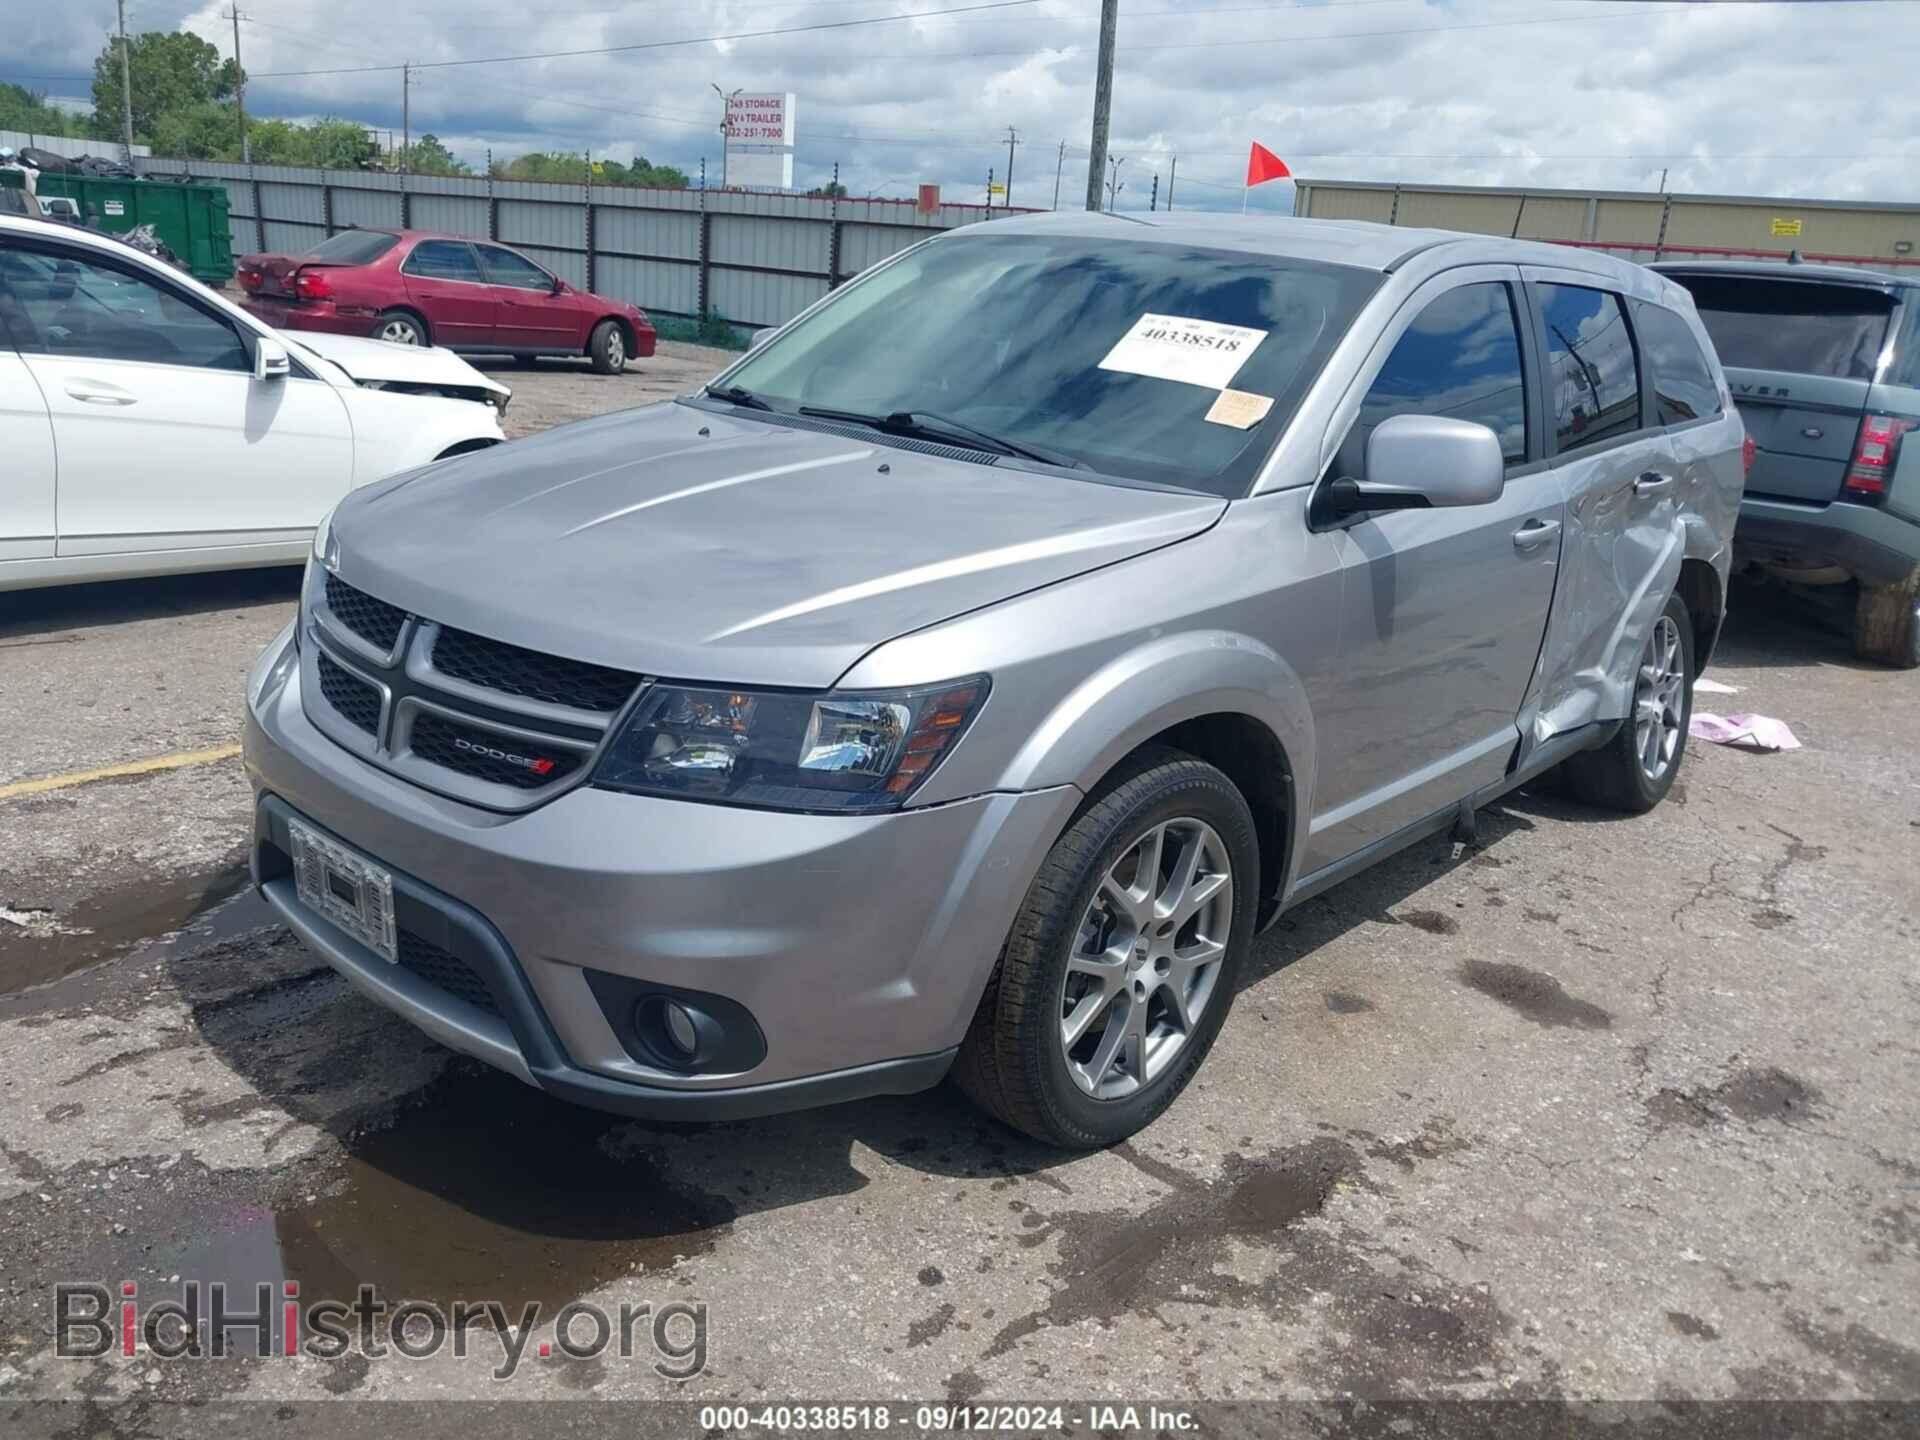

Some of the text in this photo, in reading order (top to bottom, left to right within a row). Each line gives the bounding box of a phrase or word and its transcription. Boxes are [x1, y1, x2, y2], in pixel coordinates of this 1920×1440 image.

[745, 99, 781, 109] STORAGE
[727, 113, 739, 123] RV
[746, 113, 782, 123] TRAILER
[1141, 328, 1241, 352] 40338518
[455, 738, 539, 768] DODGE
